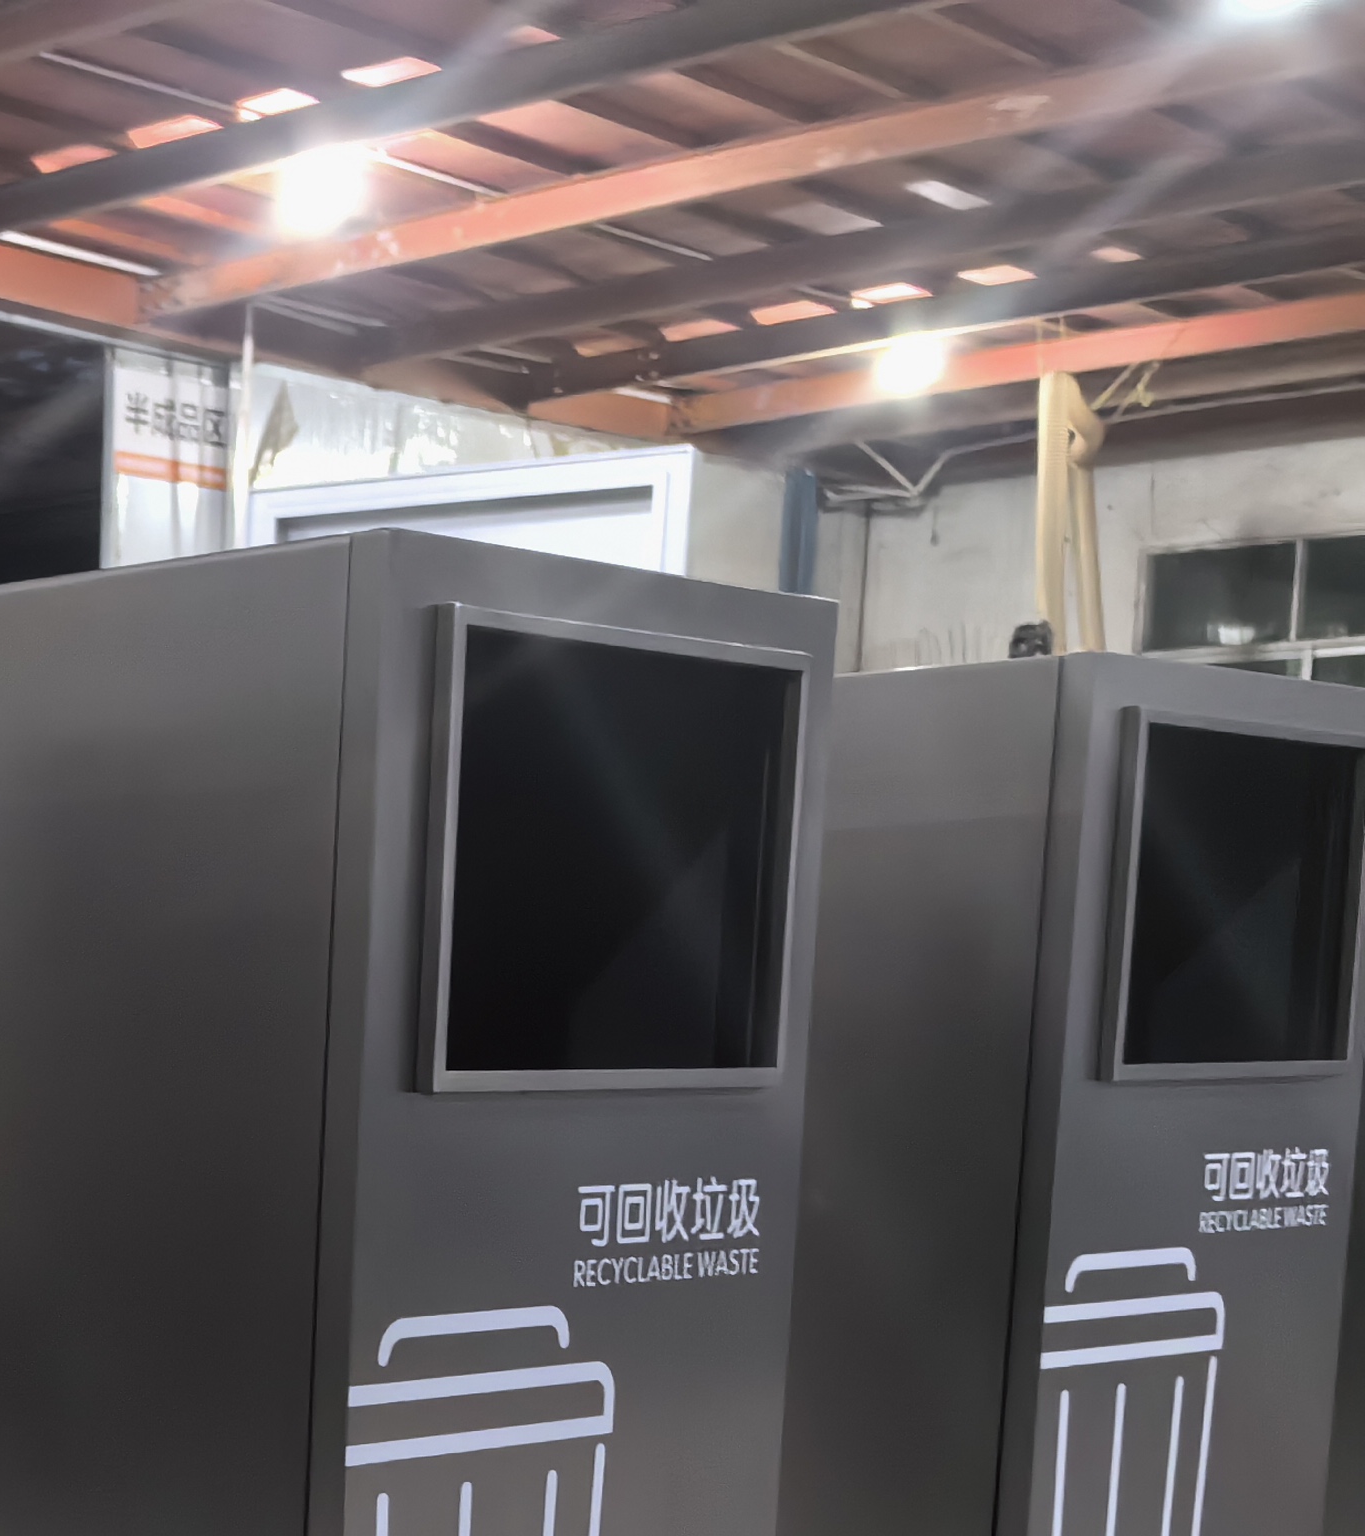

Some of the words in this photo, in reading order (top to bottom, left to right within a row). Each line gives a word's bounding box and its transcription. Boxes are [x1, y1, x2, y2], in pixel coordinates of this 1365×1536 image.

[125, 391, 226, 447] 半成品区
[1203, 1147, 1329, 1201] 可回收垃圾
[578, 1176, 759, 1247] 可回收垃圾
[573, 1253, 693, 1288] RECYCLABLE
[697, 1249, 759, 1278] WASTE
